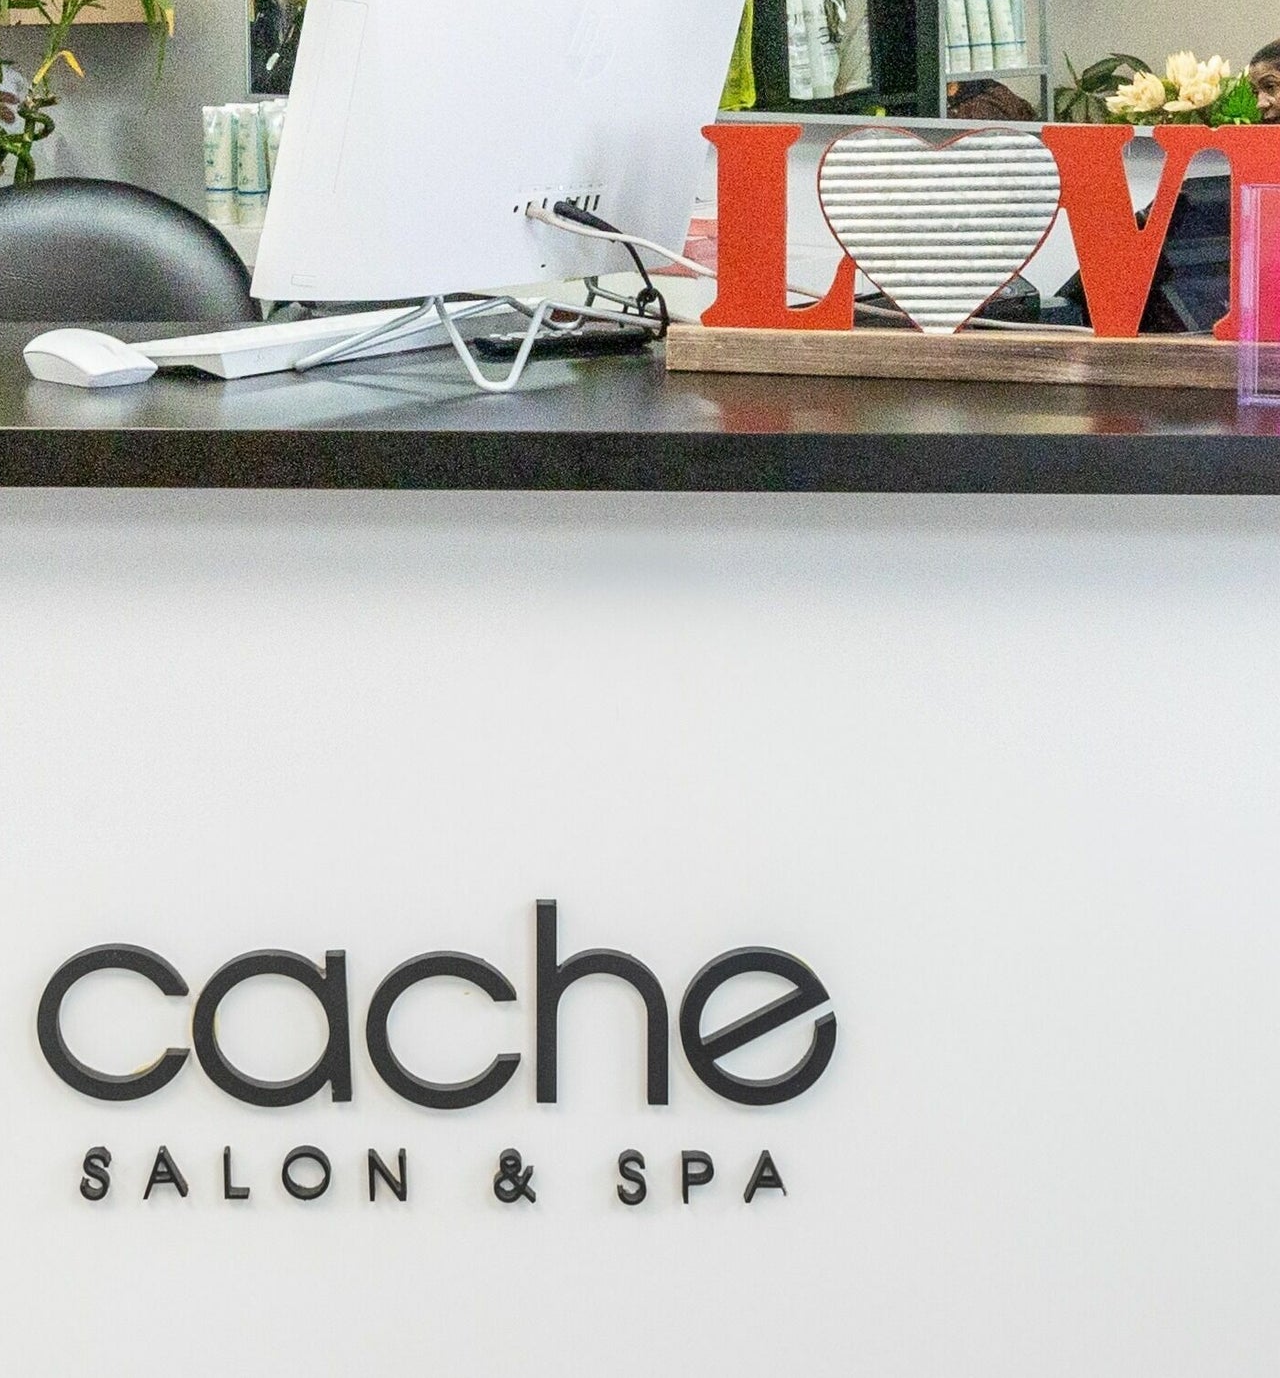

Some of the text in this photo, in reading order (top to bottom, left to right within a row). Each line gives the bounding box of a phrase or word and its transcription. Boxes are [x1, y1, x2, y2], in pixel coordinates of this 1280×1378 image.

[35, 898, 838, 1110] cache
[79, 1145, 790, 1206] SALON & SPA
